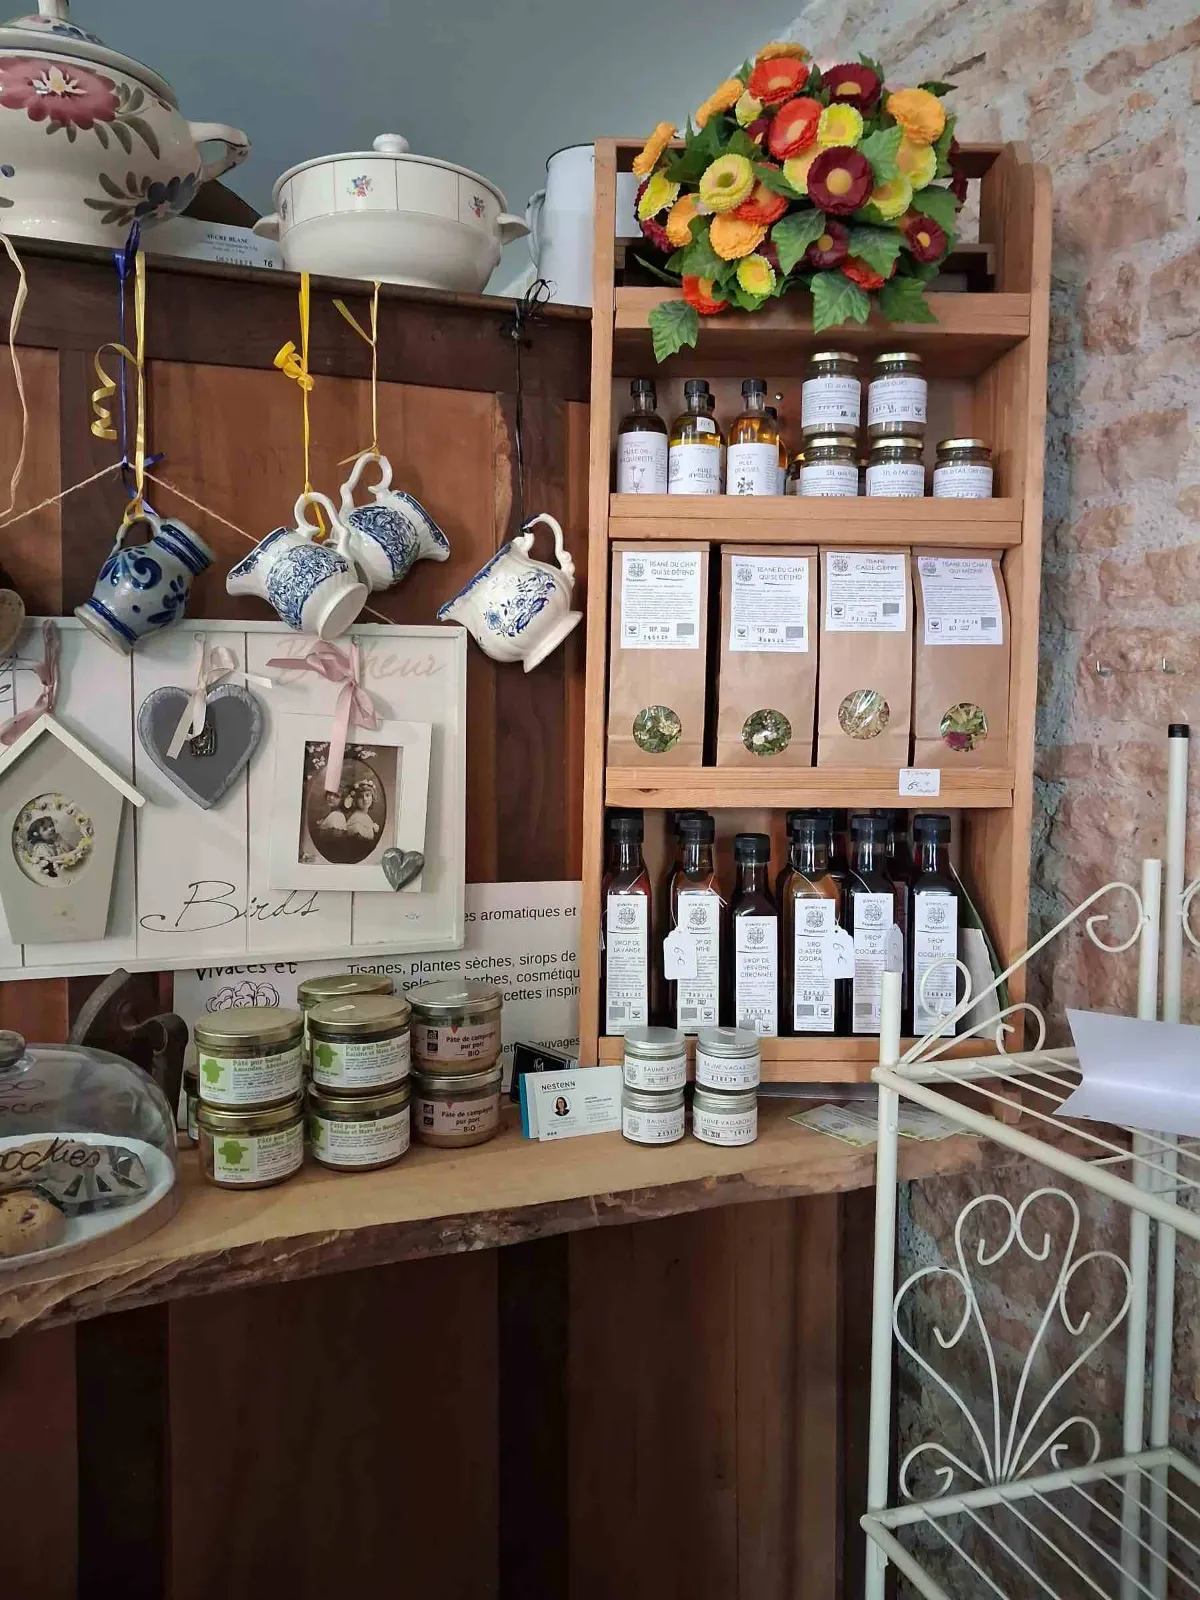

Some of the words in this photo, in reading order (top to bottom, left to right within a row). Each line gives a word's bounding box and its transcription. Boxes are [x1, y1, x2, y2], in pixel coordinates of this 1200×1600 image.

[207, 233, 226, 242] SUCRE
[228, 236, 249, 245] BLANC
[263, 259, 273, 268] 16
[670, 560, 679, 568] DU
[680, 560, 697, 568] CHAT
[671, 568, 695, 576] DÉTEND
[778, 573, 803, 581] DÉTEND
[138, 879, 321, 933] Birds
[480, 906, 561, 922] aromatiques
[564, 907, 577, 917] et
[614, 939, 631, 947] SIROP
[632, 939, 641, 947] DE
[927, 937, 945, 945] SIROP
[613, 946, 641, 954] LAVANDE
[346, 963, 406, 977] Tisanes,
[410, 958, 461, 979] plantes
[465, 955, 514, 972] sèches,
[519, 953, 557, 969] sirops
[560, 952, 577, 965] de
[761, 957, 771, 965] DE
[274, 962, 298, 975] et
[446, 1035, 461, 1043] Pâté
[462, 1034, 470, 1043] de
[362, 1044, 374, 1053] pur
[460, 1042, 472, 1051] pur
[467, 1049, 480, 1058] BIO
[250, 1058, 263, 1067] pur
[643, 1066, 666, 1074] BAUME
[457, 1110, 466, 1118] de
[455, 1118, 467, 1127] pur
[463, 1124, 476, 1133] BIO
[0, 1136, 101, 1173] ockies
